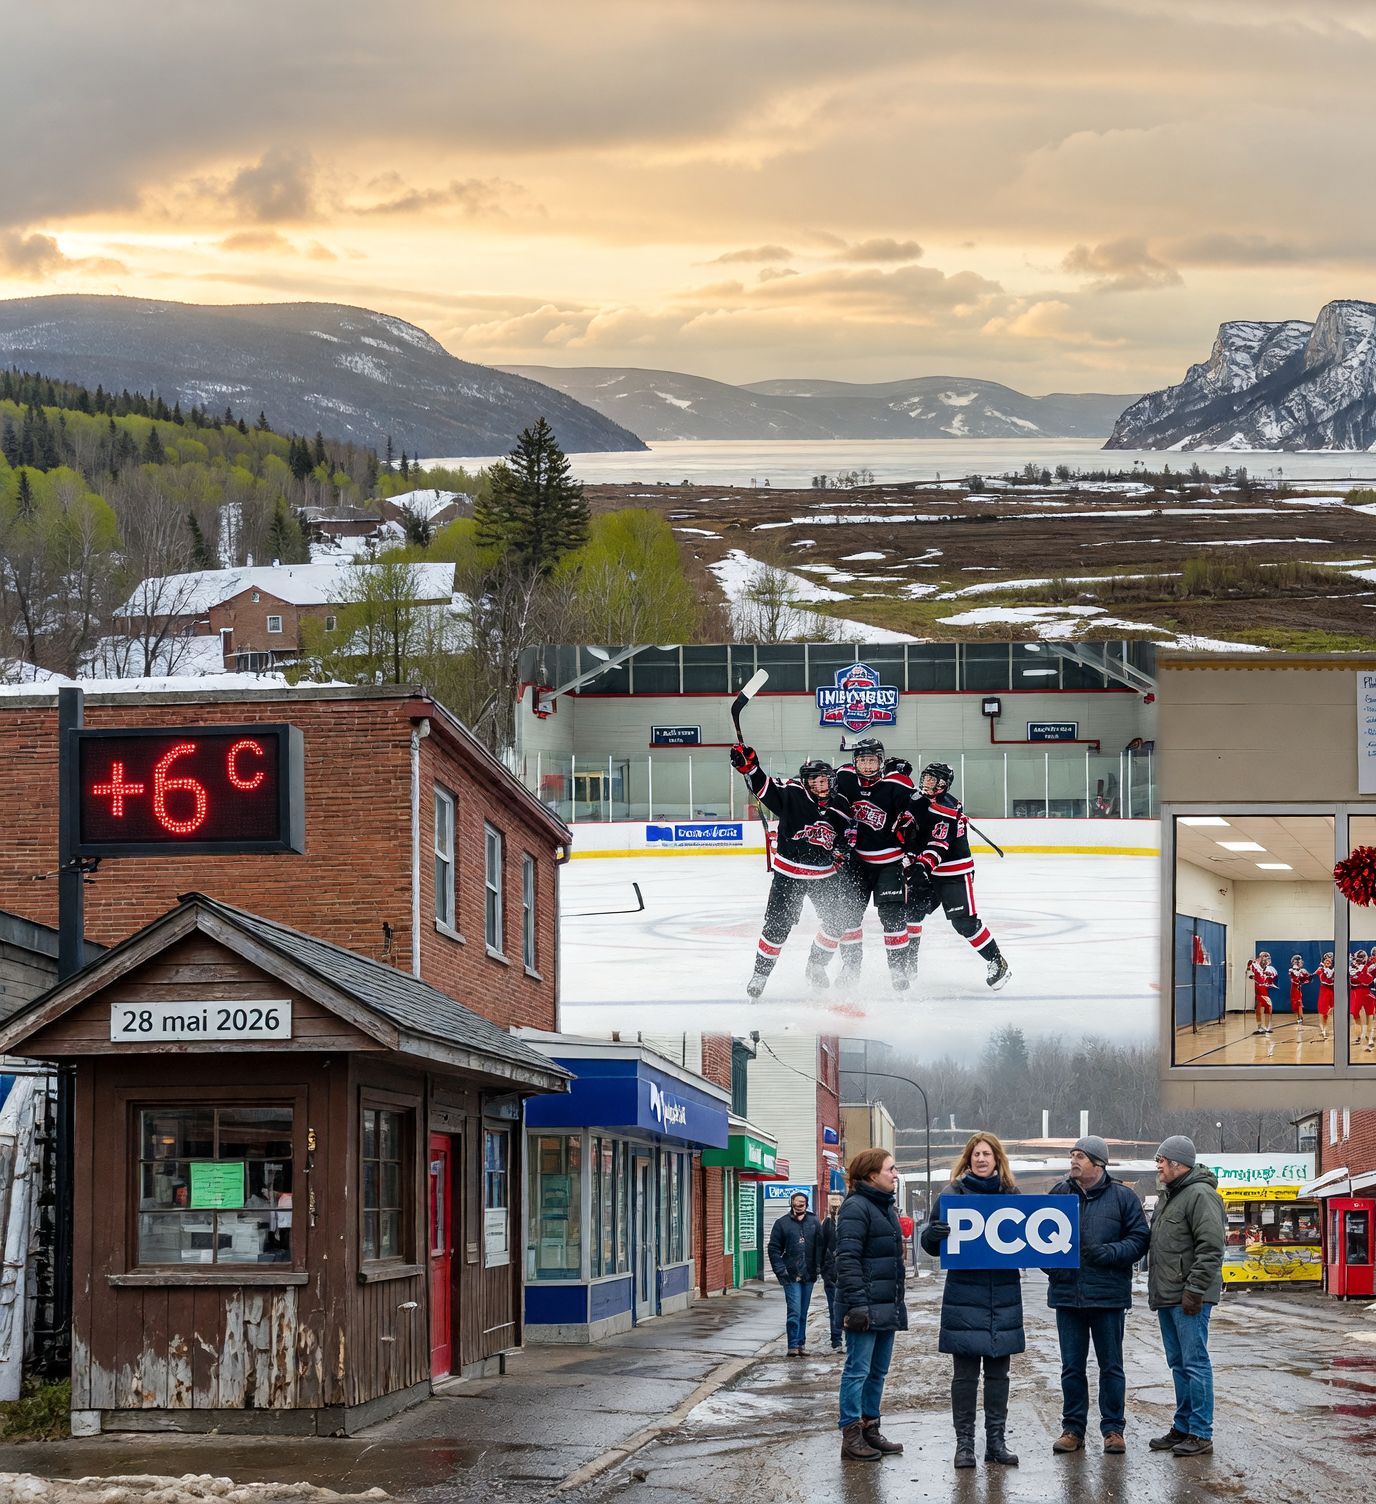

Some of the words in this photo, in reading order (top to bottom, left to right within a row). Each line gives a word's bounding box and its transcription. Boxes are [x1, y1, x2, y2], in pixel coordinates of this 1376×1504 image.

[227, 739, 265, 790] C
[122, 1010, 153, 1033] 28
[162, 1008, 208, 1032] mai
[216, 1008, 280, 1031] 2026
[946, 1207, 1073, 1255] PCQ
